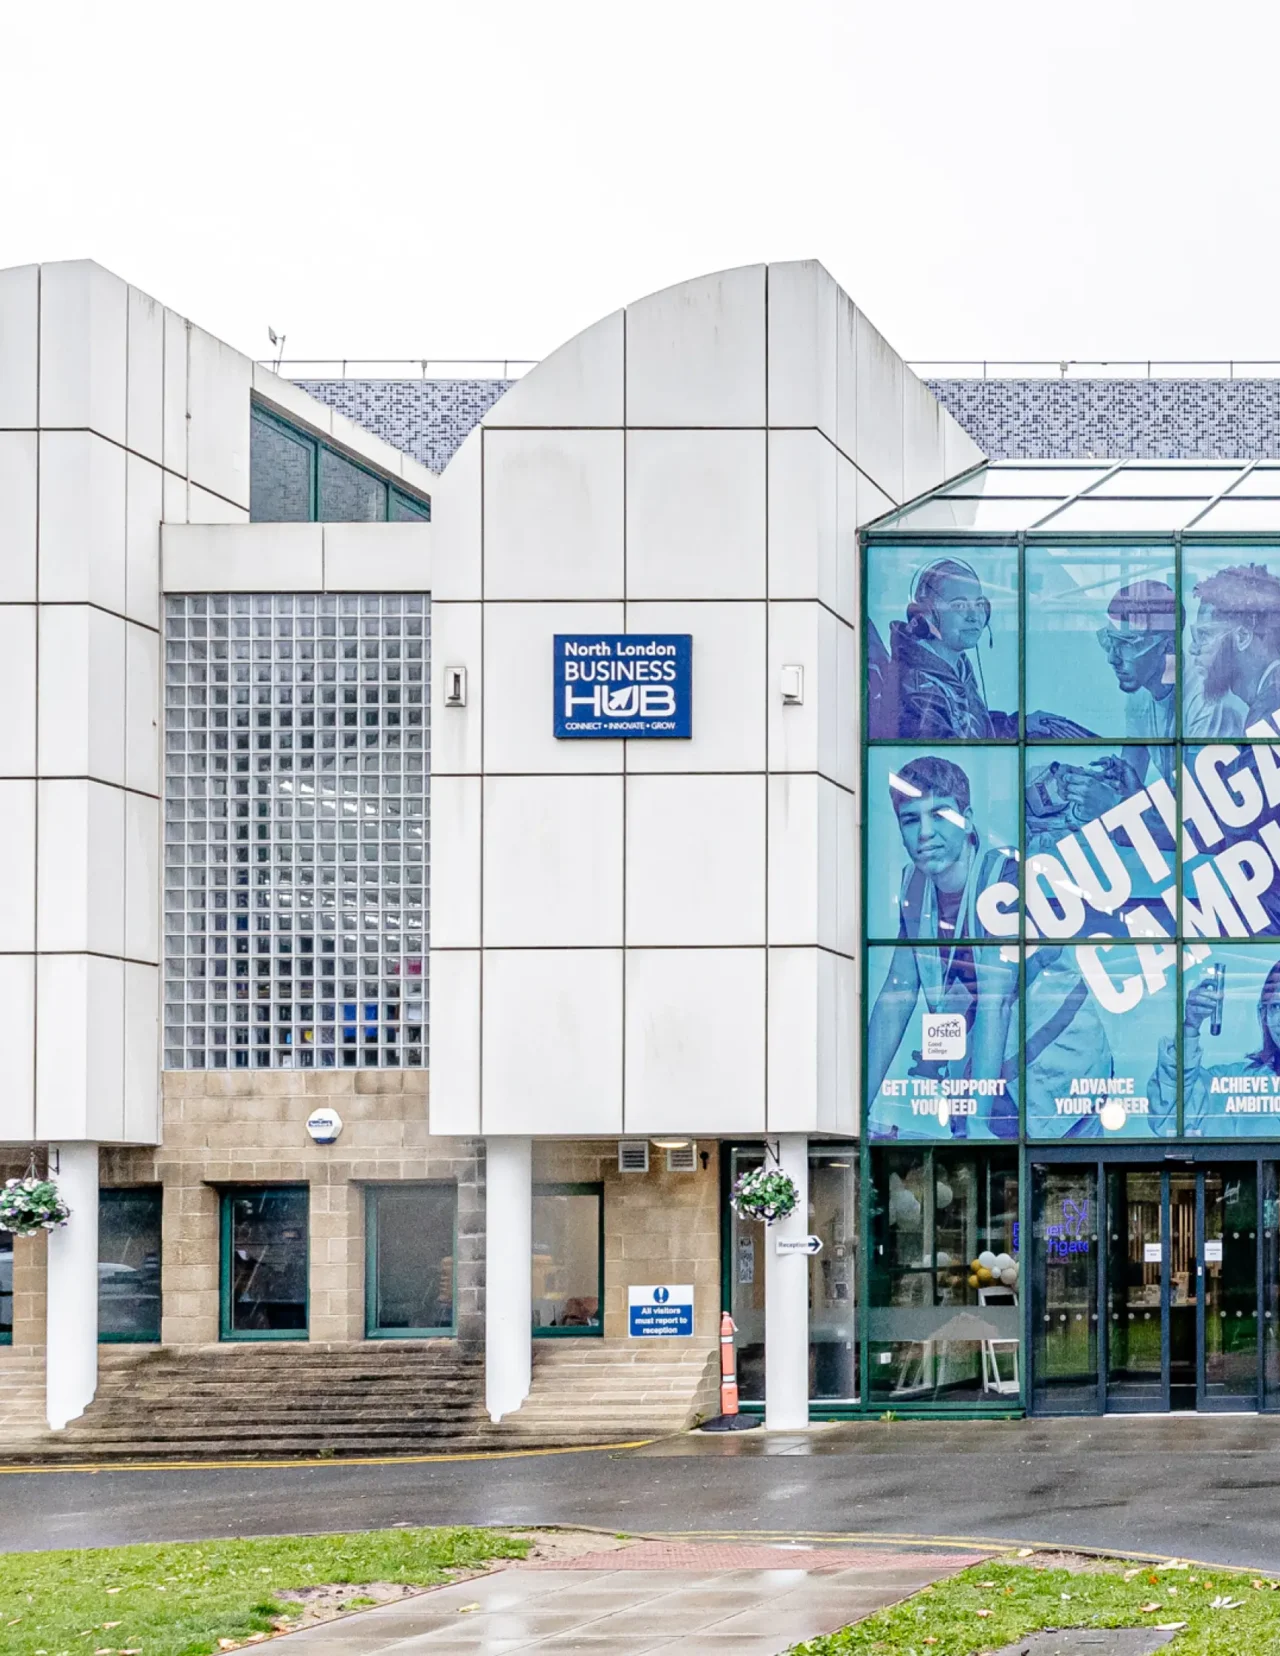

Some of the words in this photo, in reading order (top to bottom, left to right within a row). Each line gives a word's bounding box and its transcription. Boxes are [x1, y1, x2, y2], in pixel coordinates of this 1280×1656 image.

[565, 641, 611, 656] North
[617, 641, 676, 656] London
[565, 660, 676, 681] BUSINESS
[565, 684, 676, 717] HUB
[565, 722, 602, 730] CONNECT
[608, 722, 645, 730] INNOVATE
[651, 721, 676, 730] GROW
[927, 1026, 962, 1038] Ofsted
[882, 1079, 908, 1096] GET
[911, 1079, 938, 1096] THE
[941, 1079, 1006, 1096] SUPPORT
[1069, 1078, 1134, 1095] ADVANCE
[1210, 1076, 1269, 1094] ACHIEVE
[911, 1098, 938, 1115] YOU
[1055, 1098, 1092, 1115] YOUR
[778, 1241, 807, 1249] Reception
[635, 1317, 654, 1325] must
[655, 1317, 678, 1325] report
[642, 1326, 678, 1335] reception
